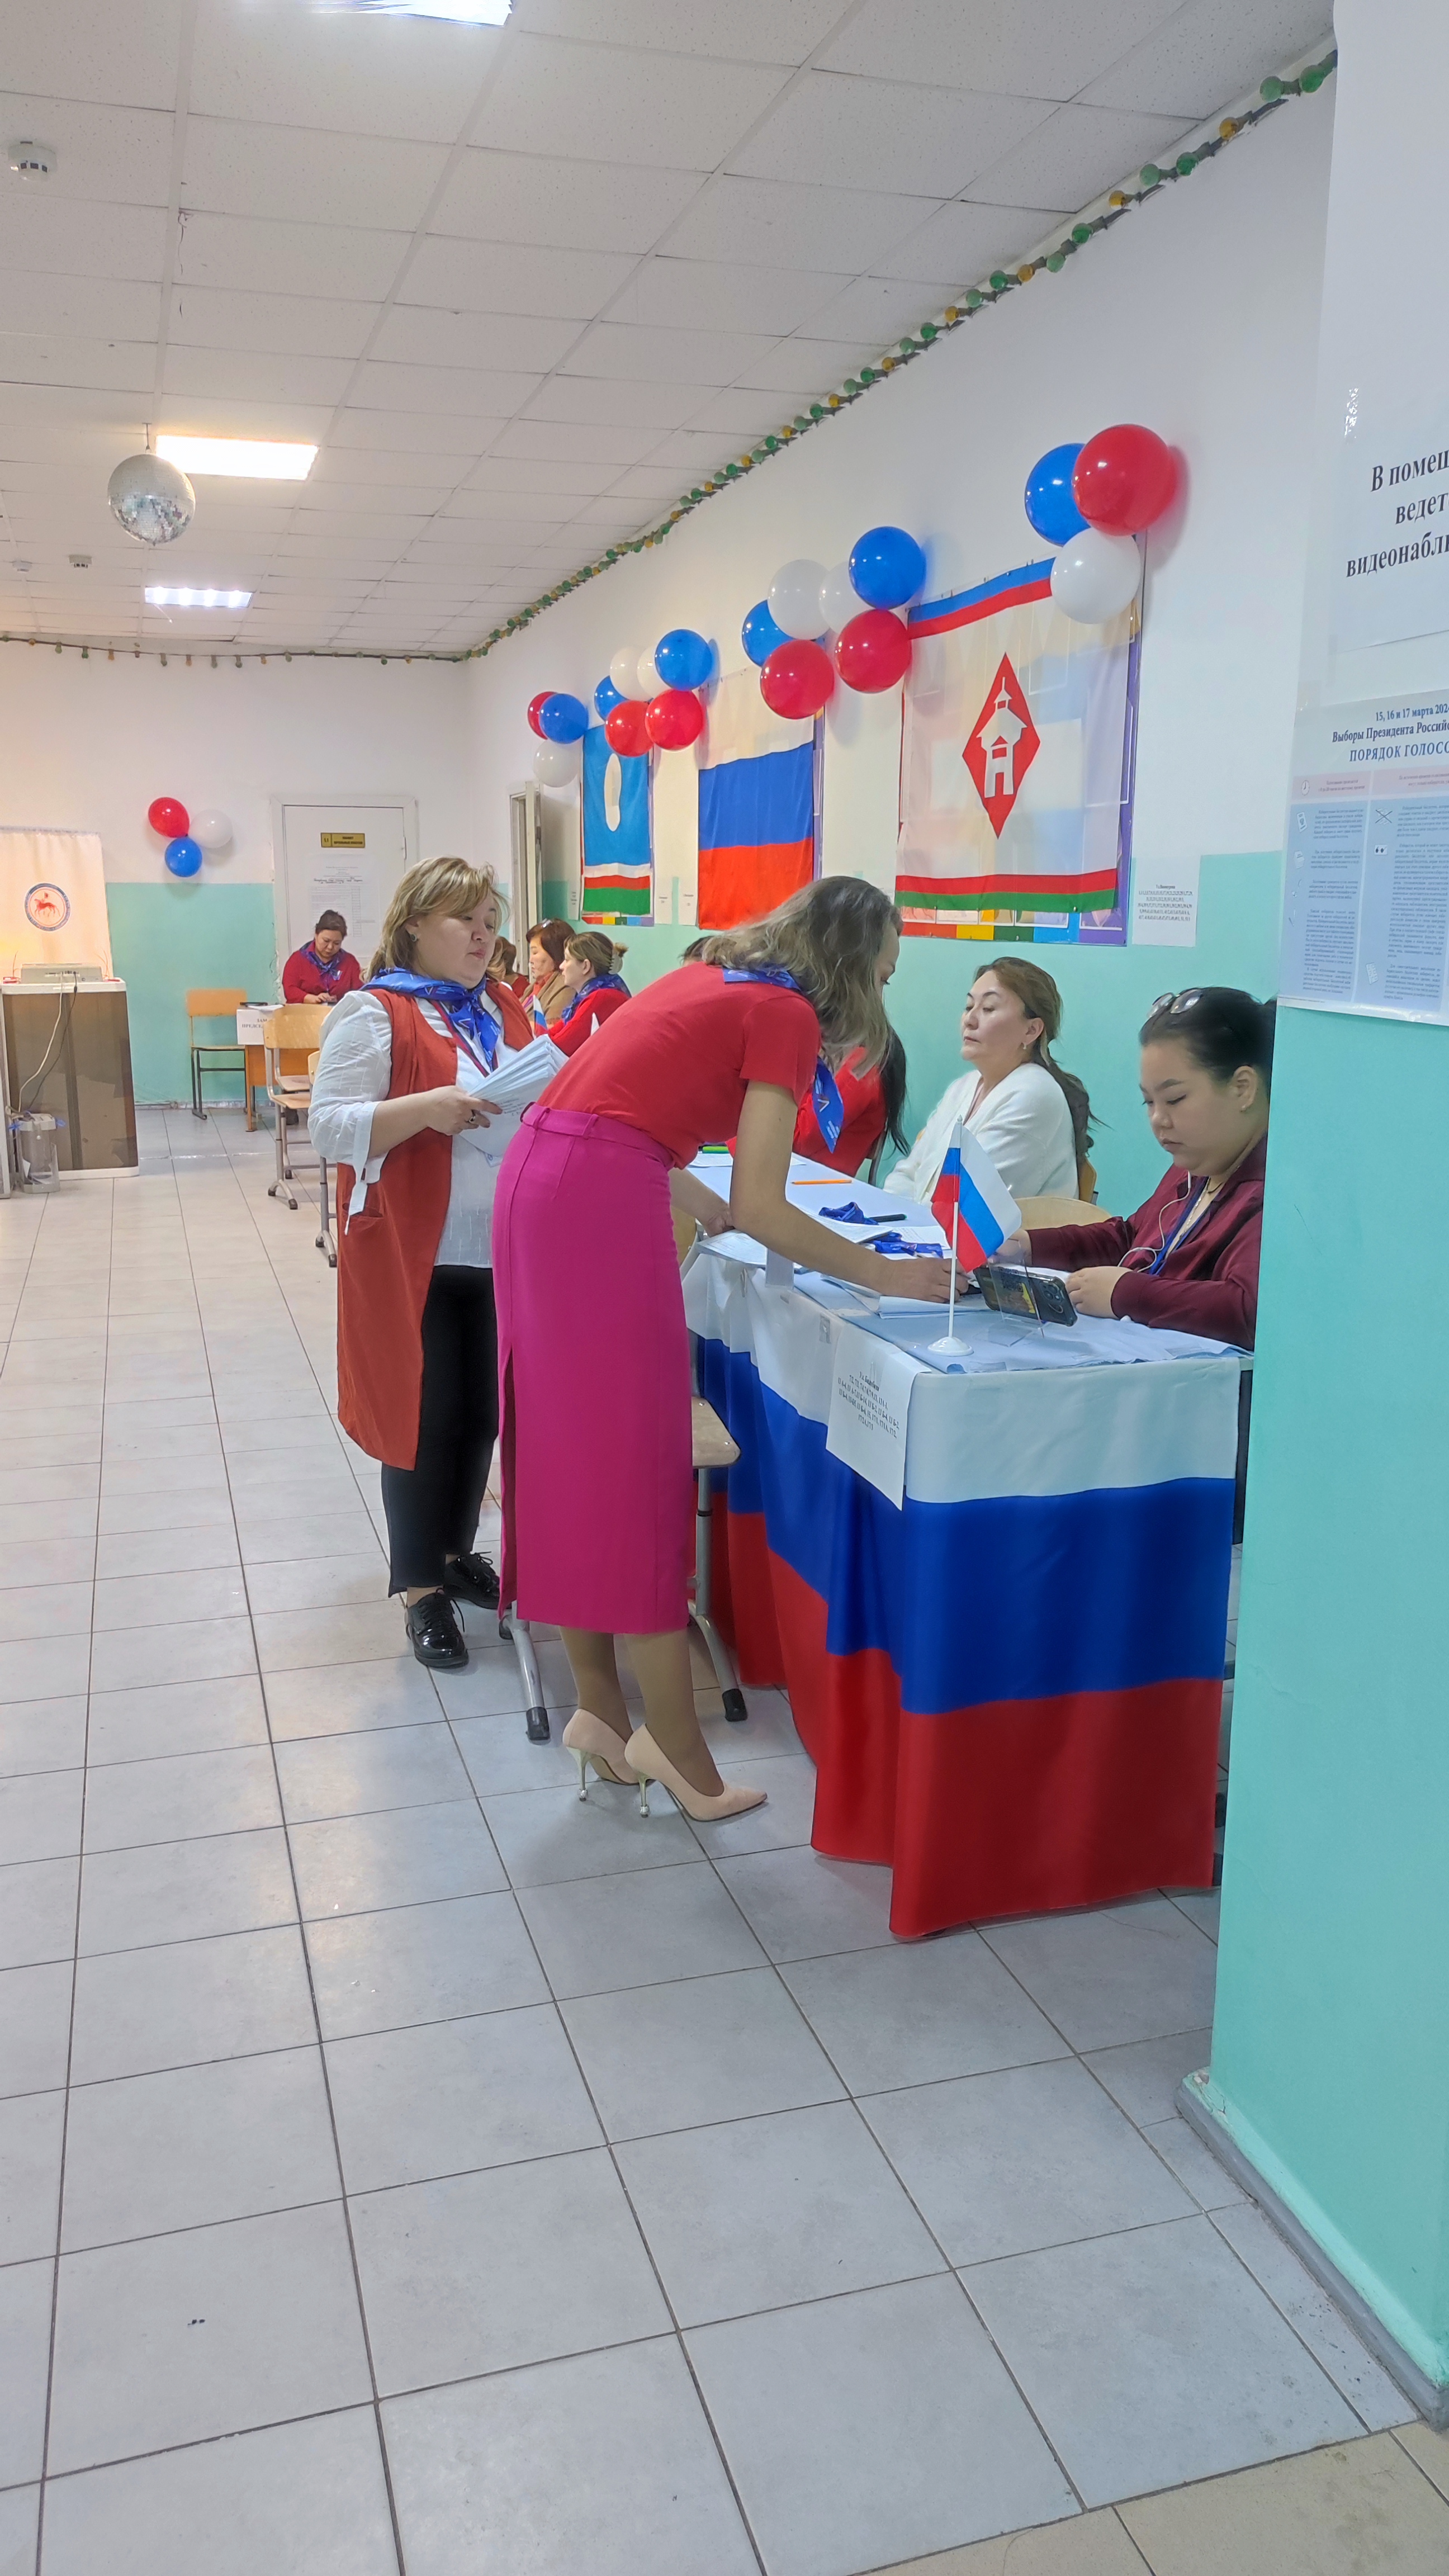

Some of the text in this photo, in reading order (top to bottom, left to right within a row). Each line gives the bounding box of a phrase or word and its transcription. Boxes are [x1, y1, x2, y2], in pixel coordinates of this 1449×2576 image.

[1371, 465, 1383, 492] В
[1395, 492, 1449, 524] ведет
[1346, 532, 1449, 577] видеонабл
[1376, 712, 1385, 722] 15,
[1387, 710, 1395, 720] 16
[1403, 708, 1410, 718] 17
[1412, 707, 1433, 719] марта
[1435, 703, 1449, 714] 202
[1332, 730, 1364, 744] Выборы
[1366, 726, 1414, 741] Президента
[1349, 745, 1401, 762] ПОРЯДОК
